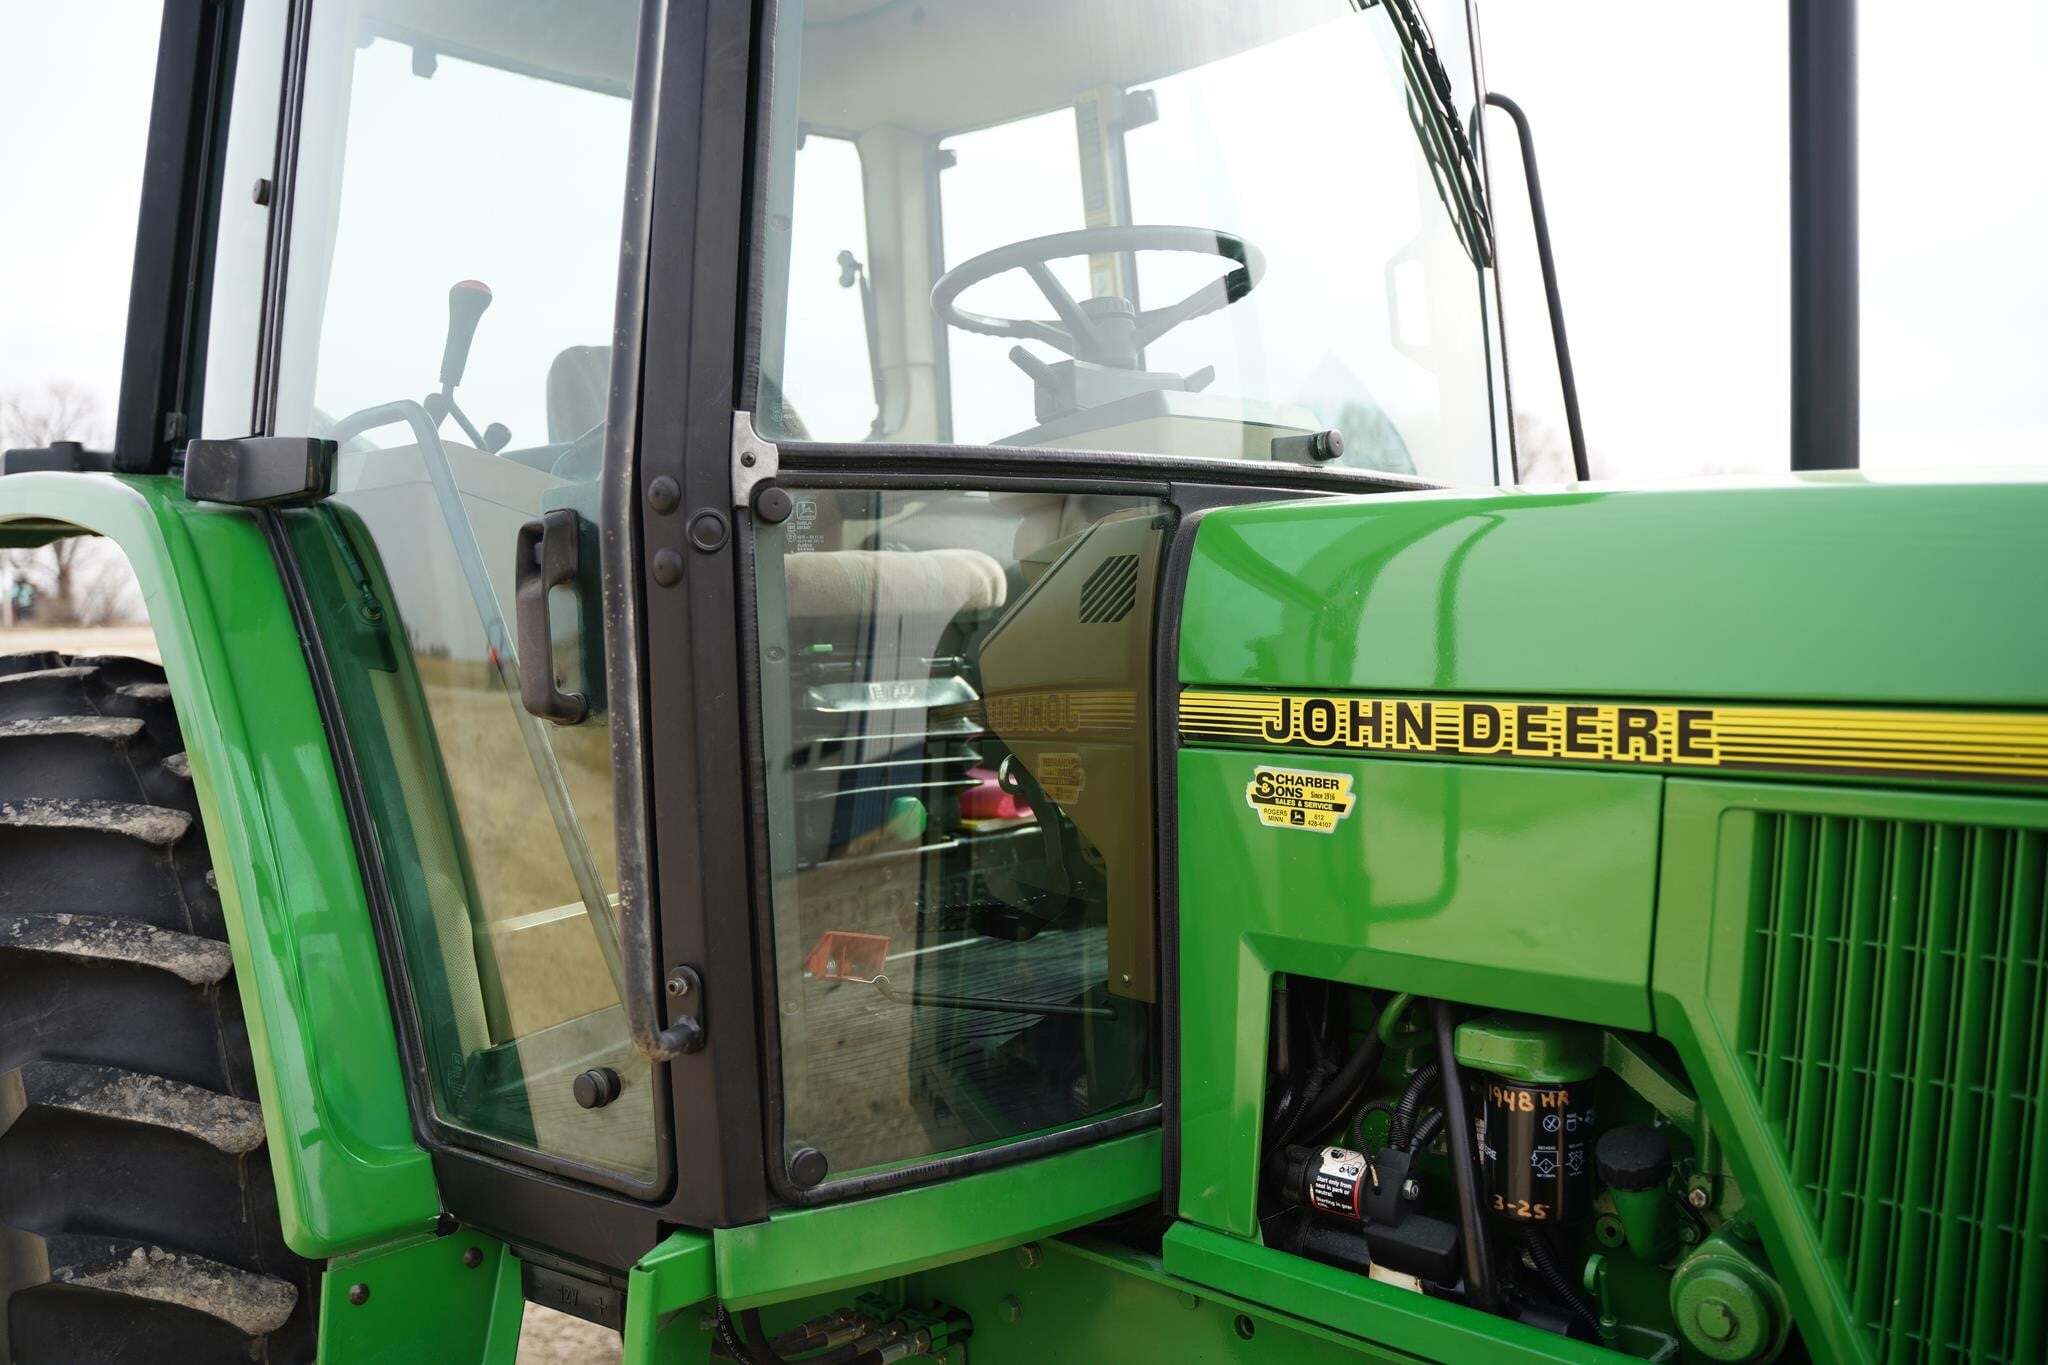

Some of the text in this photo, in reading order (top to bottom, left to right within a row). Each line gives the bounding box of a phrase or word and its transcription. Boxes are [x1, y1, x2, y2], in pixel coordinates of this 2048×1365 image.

[1263, 697, 1719, 765] JOHN DEERE
[1263, 807, 1288, 817] ROGERS
[1275, 797, 1296, 807] SALES
[1303, 801, 1333, 811] SERVICE
[1488, 1084, 1535, 1112] 1948
[1328, 1179, 1340, 1188] only
[1340, 1182, 1353, 1190] from
[1493, 1194, 1551, 1219] 3-25
